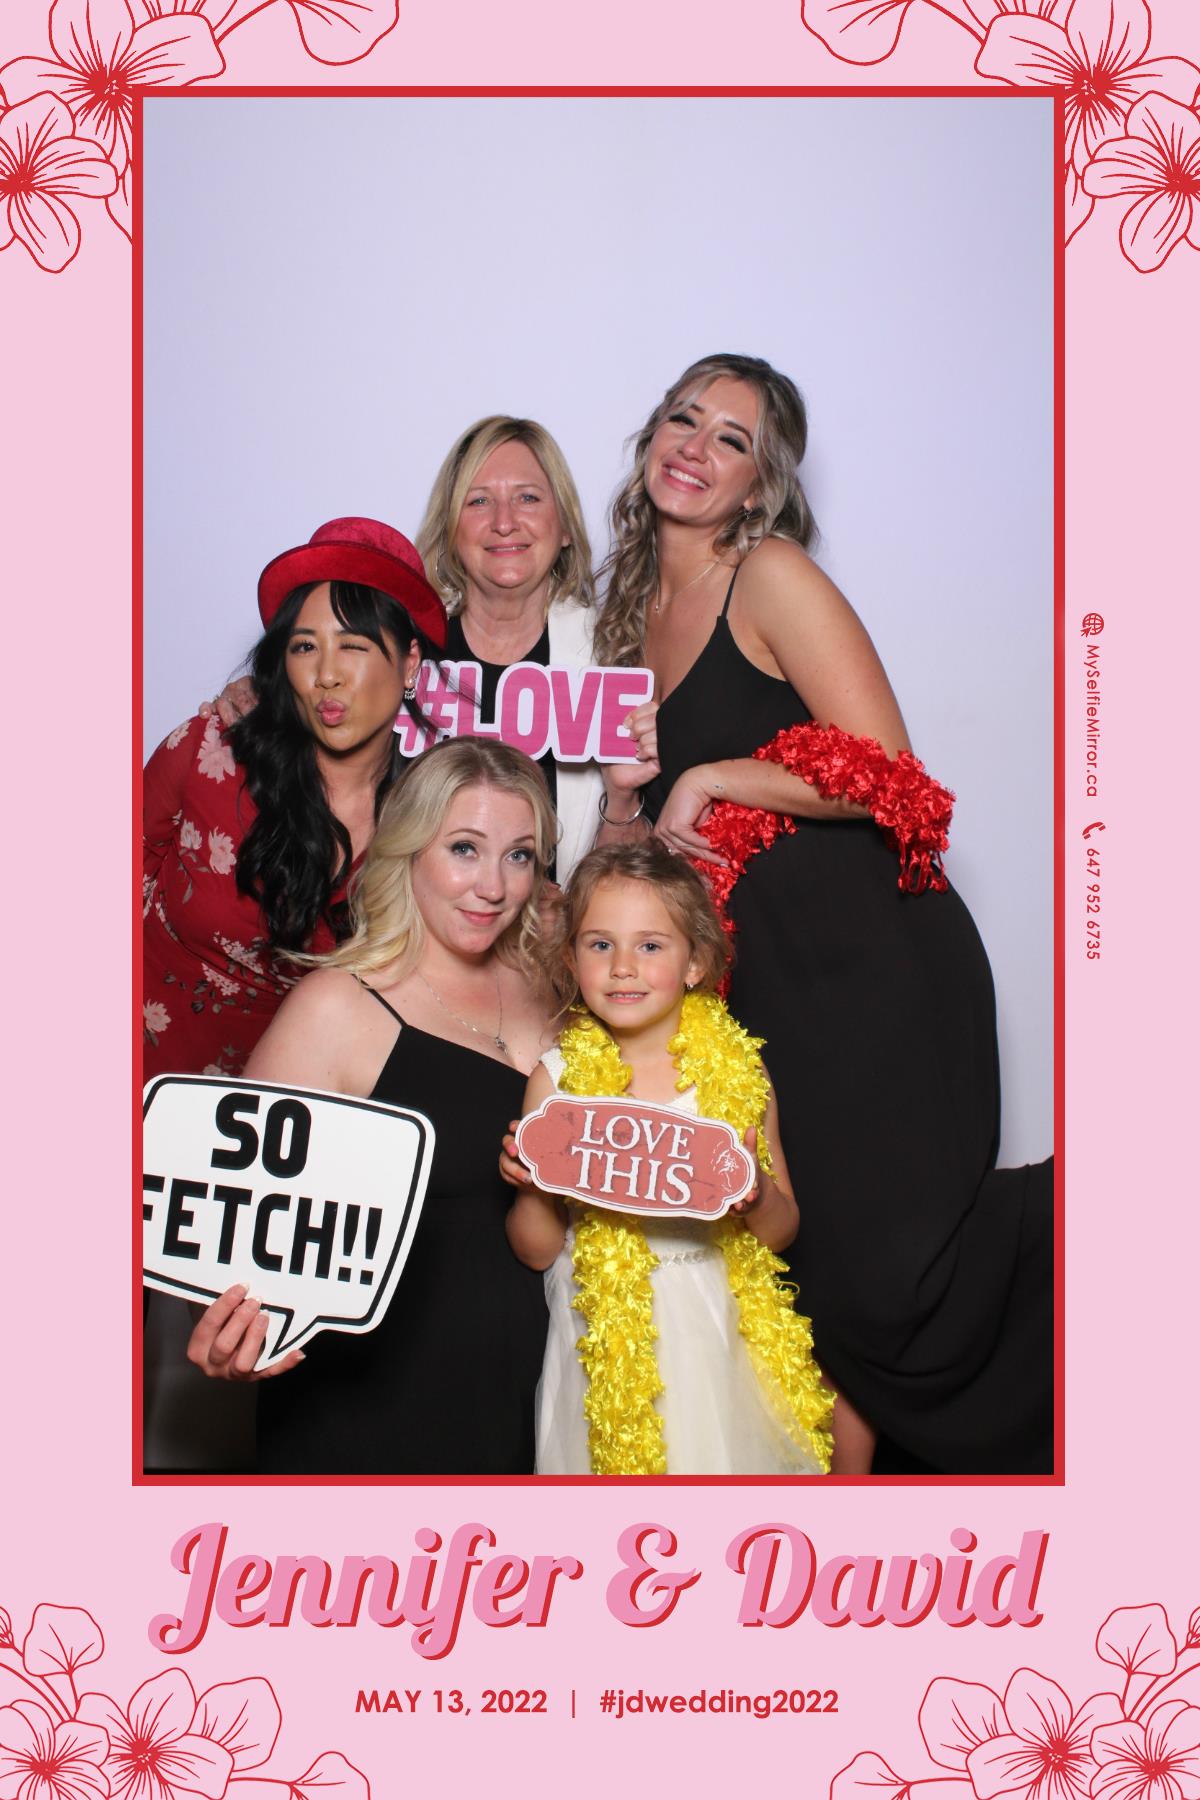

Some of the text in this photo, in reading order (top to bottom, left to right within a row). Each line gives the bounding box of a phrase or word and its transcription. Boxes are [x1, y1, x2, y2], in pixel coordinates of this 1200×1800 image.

[396, 666, 649, 757] #LOVE
[210, 1092, 312, 1179] SO
[579, 1109, 695, 1160] LOVE
[571, 1145, 694, 1205] THIS
